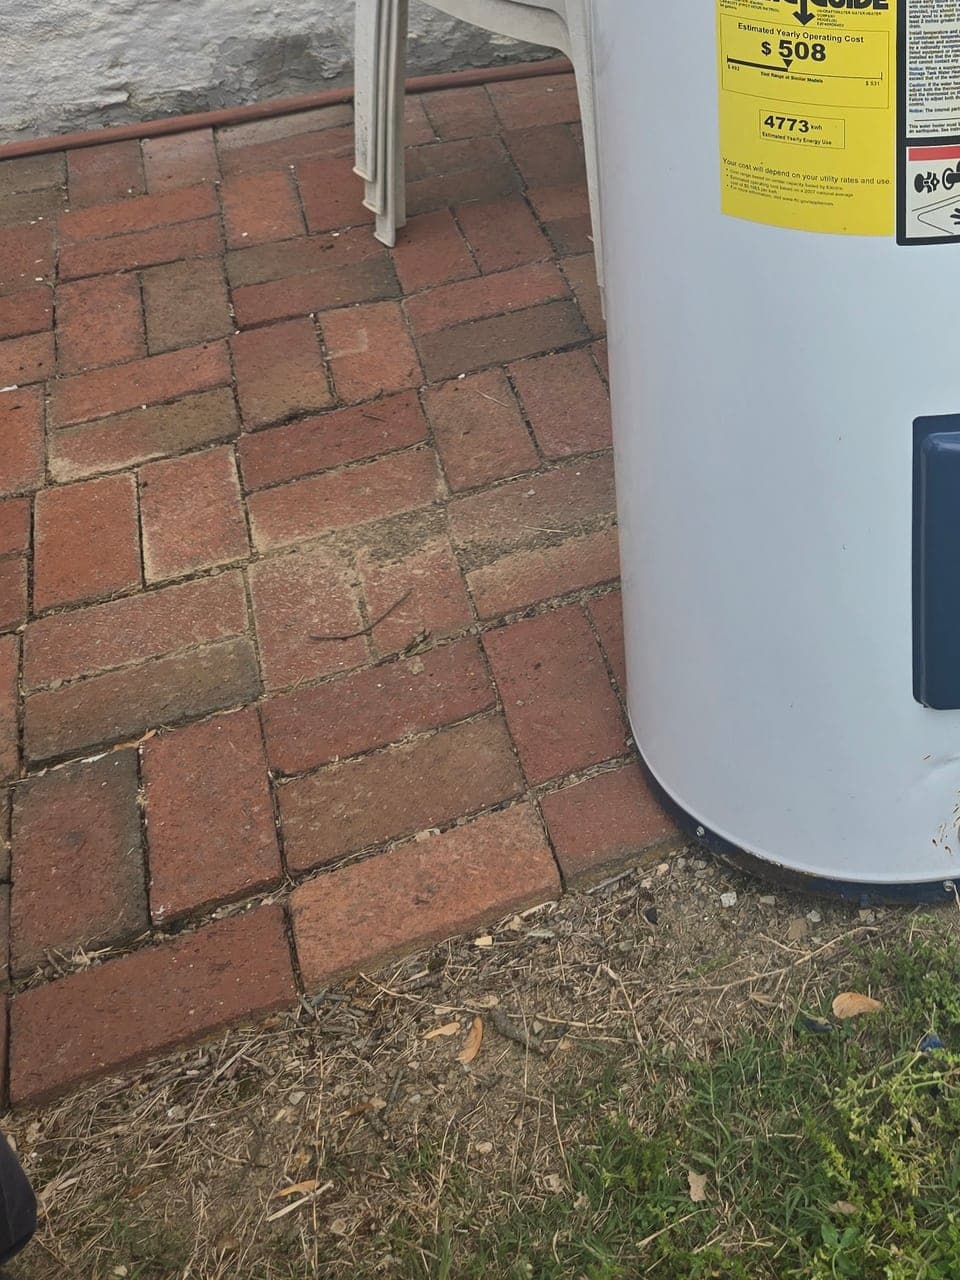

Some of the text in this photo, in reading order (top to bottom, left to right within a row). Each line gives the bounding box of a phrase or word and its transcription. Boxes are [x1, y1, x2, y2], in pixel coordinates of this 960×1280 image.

[738, 22, 864, 43] Estimated Yearly Operating Cost
[761, 39, 826, 62] $ 508
[764, 115, 809, 133] 4773
[803, 137, 821, 145] Energy
[722, 157, 737, 166] Your
[752, 164, 764, 172] will
[765, 167, 790, 178] depend
[802, 174, 818, 182] your
[820, 174, 839, 184] utility
